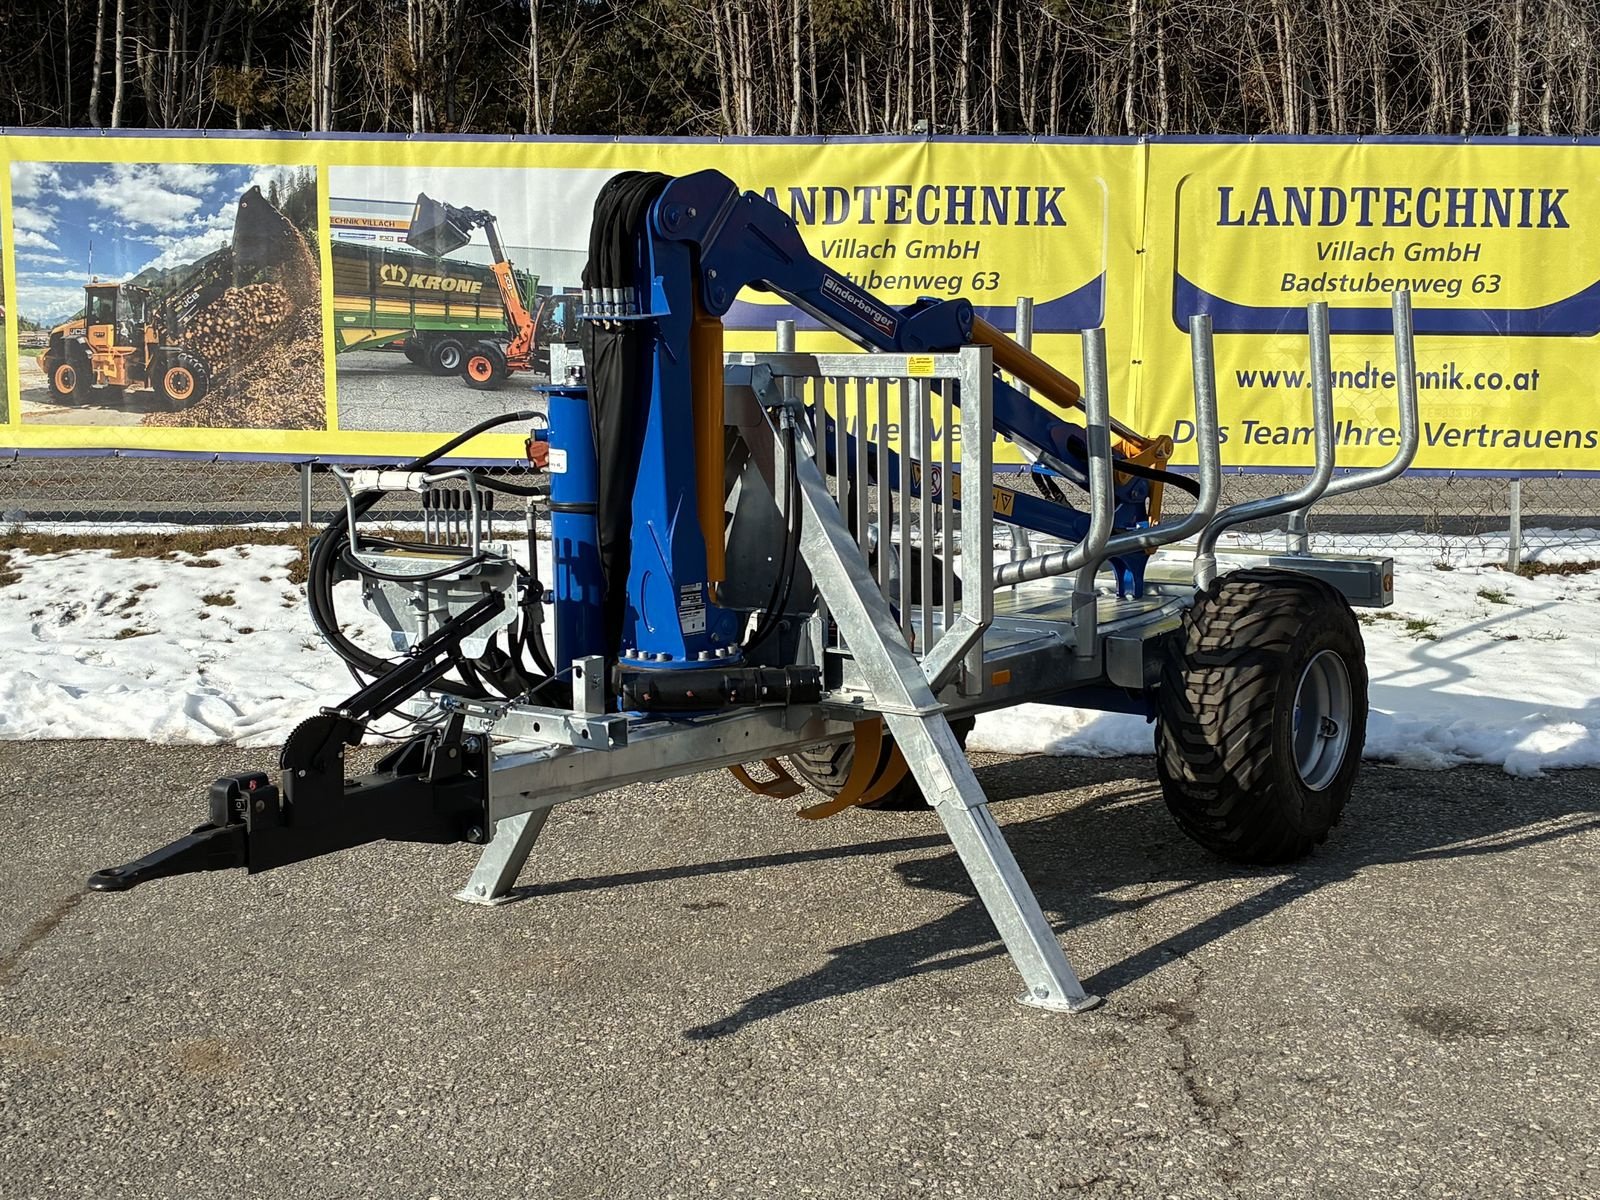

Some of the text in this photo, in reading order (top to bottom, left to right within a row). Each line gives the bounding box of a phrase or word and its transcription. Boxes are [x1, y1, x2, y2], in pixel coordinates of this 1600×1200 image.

[763, 185, 1067, 227] NDTECHNIK
[1217, 186, 1570, 229] LANDTECHNIK
[330, 216, 395, 228] ECHNIK VILLACH
[821, 238, 980, 259] Villach GmbH
[1317, 240, 1481, 262] Villach GmbH
[408, 273, 483, 295] KRONE
[845, 271, 1000, 295] ubenweg 63
[1280, 271, 1502, 298] Badstubenweg 63
[182, 292, 200, 308] JCB
[824, 278, 893, 326] Binderberger
[1236, 360, 1541, 391] www.ndtehnik.co.at
[1172, 419, 1230, 445] Ds
[1242, 420, 1315, 445] Team
[1424, 421, 1598, 449] Vertrauens
